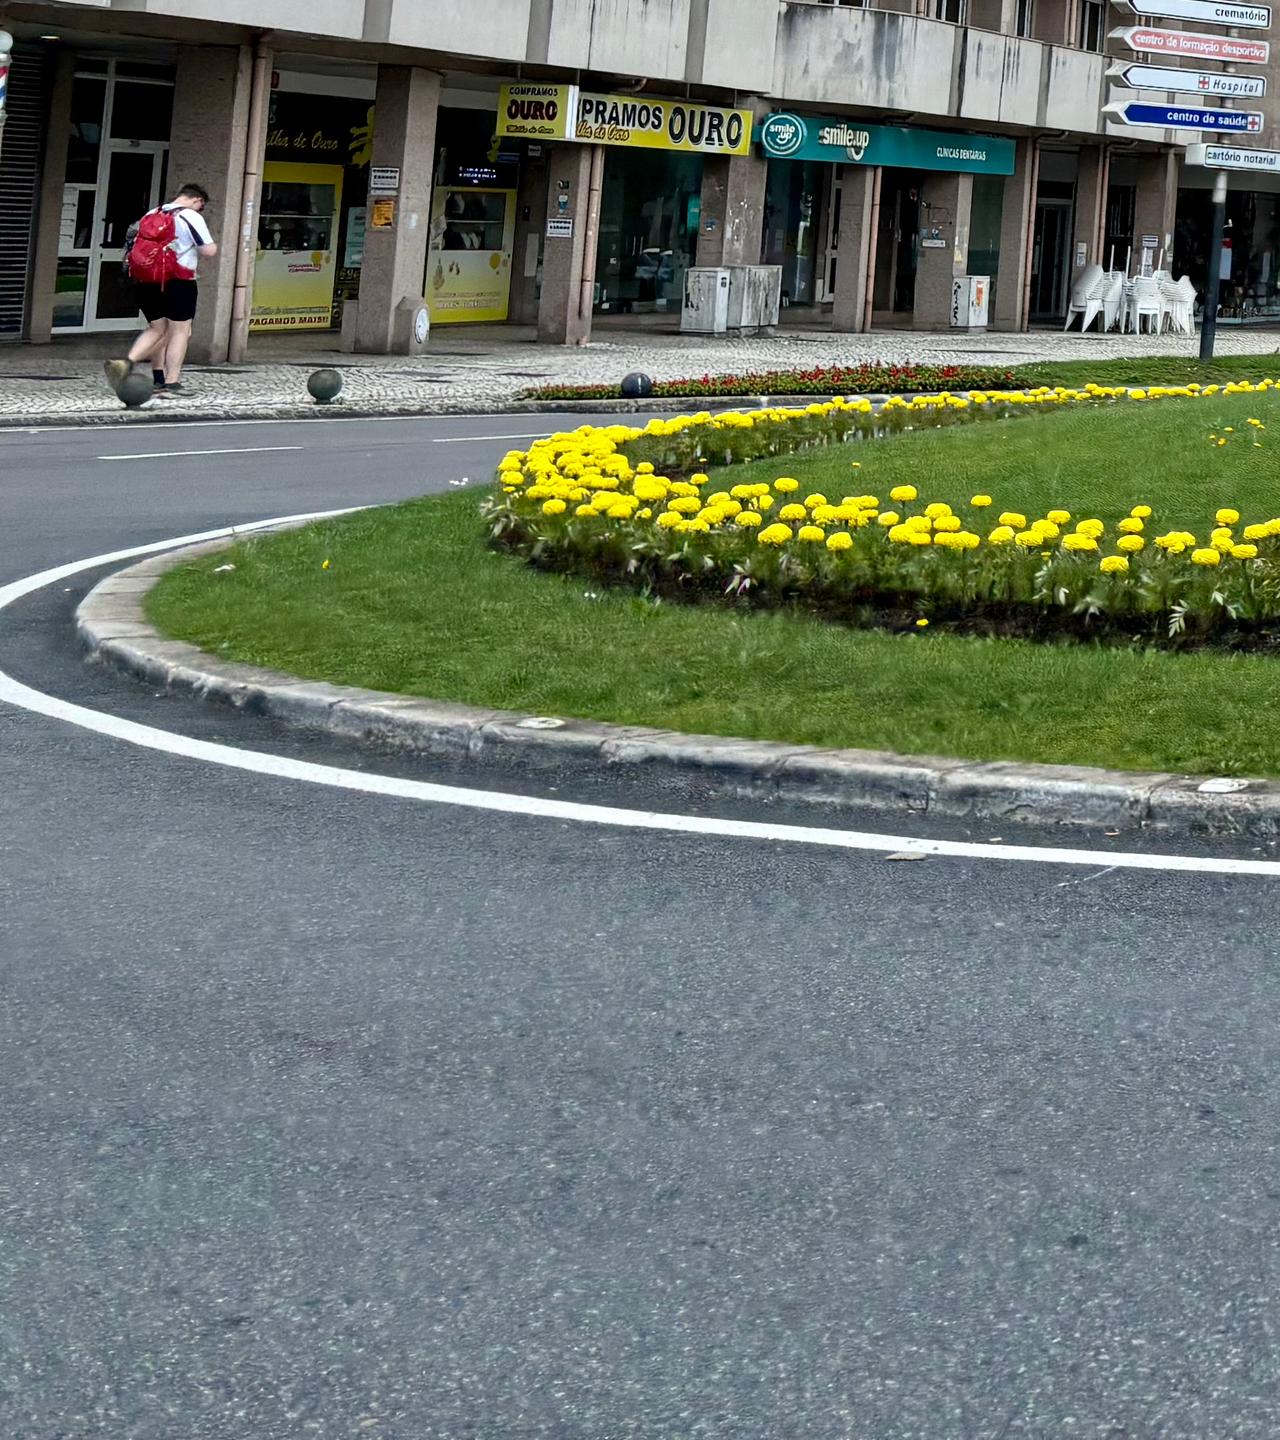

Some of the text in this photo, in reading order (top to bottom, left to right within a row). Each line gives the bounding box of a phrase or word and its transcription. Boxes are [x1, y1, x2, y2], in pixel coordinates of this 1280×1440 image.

[1215, 7, 1267, 22] crematório
[1135, 33, 1266, 58] centro de formação desportiva
[509, 86, 558, 97] COMPRAMOS
[1213, 78, 1259, 93] Hospital
[507, 99, 557, 122] OURO
[1167, 111, 1248, 127] centro de saúde
[668, 106, 743, 149] OURO
[1207, 150, 1277, 166] cartório notarial
